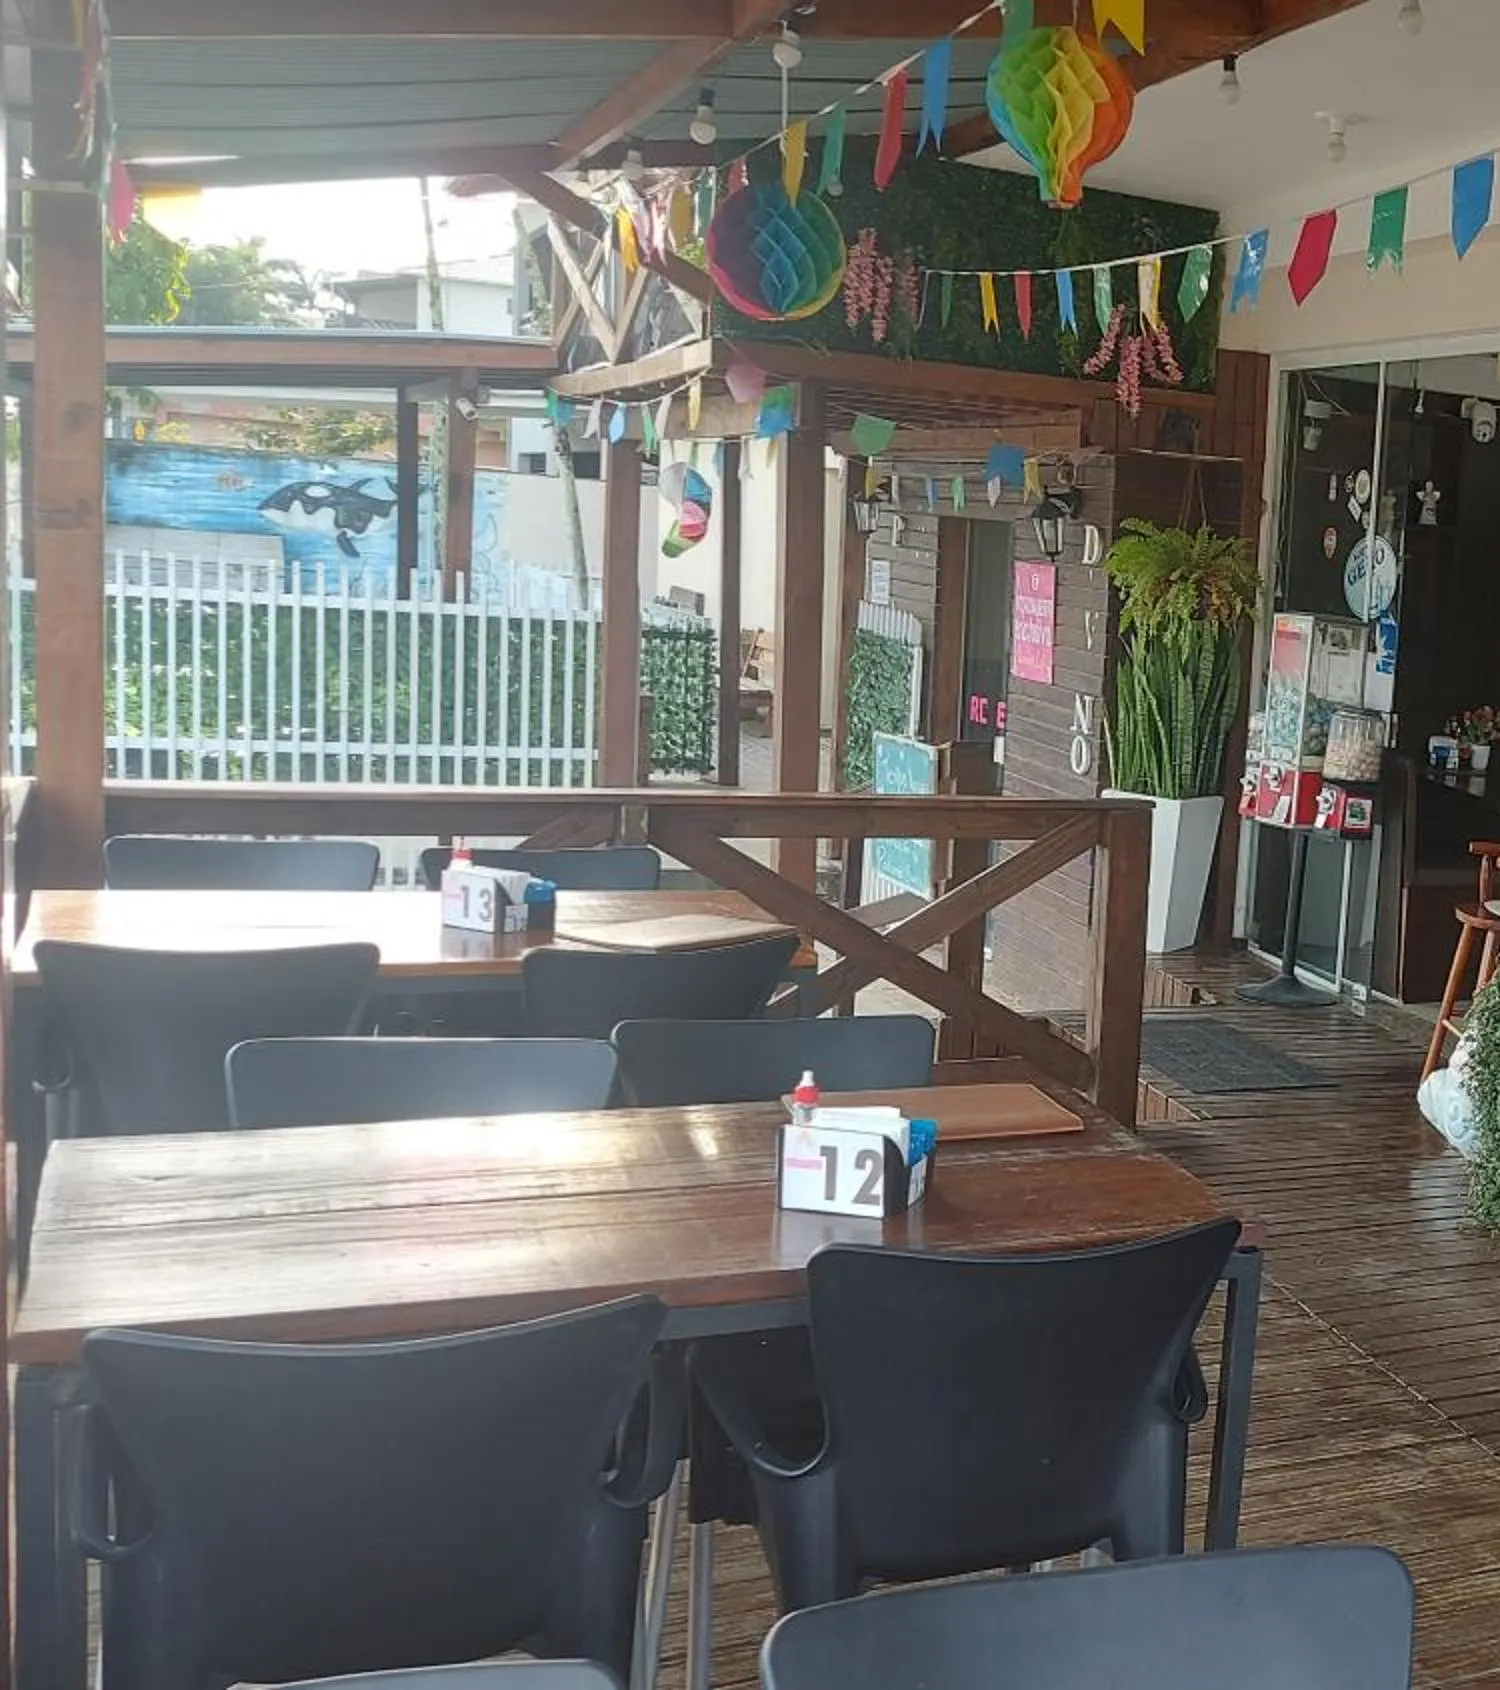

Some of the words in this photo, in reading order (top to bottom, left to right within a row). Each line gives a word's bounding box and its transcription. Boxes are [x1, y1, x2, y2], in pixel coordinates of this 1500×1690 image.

[1347, 547, 1386, 587] GEO
[461, 885, 492, 922] 13
[820, 1145, 883, 1206] 12
